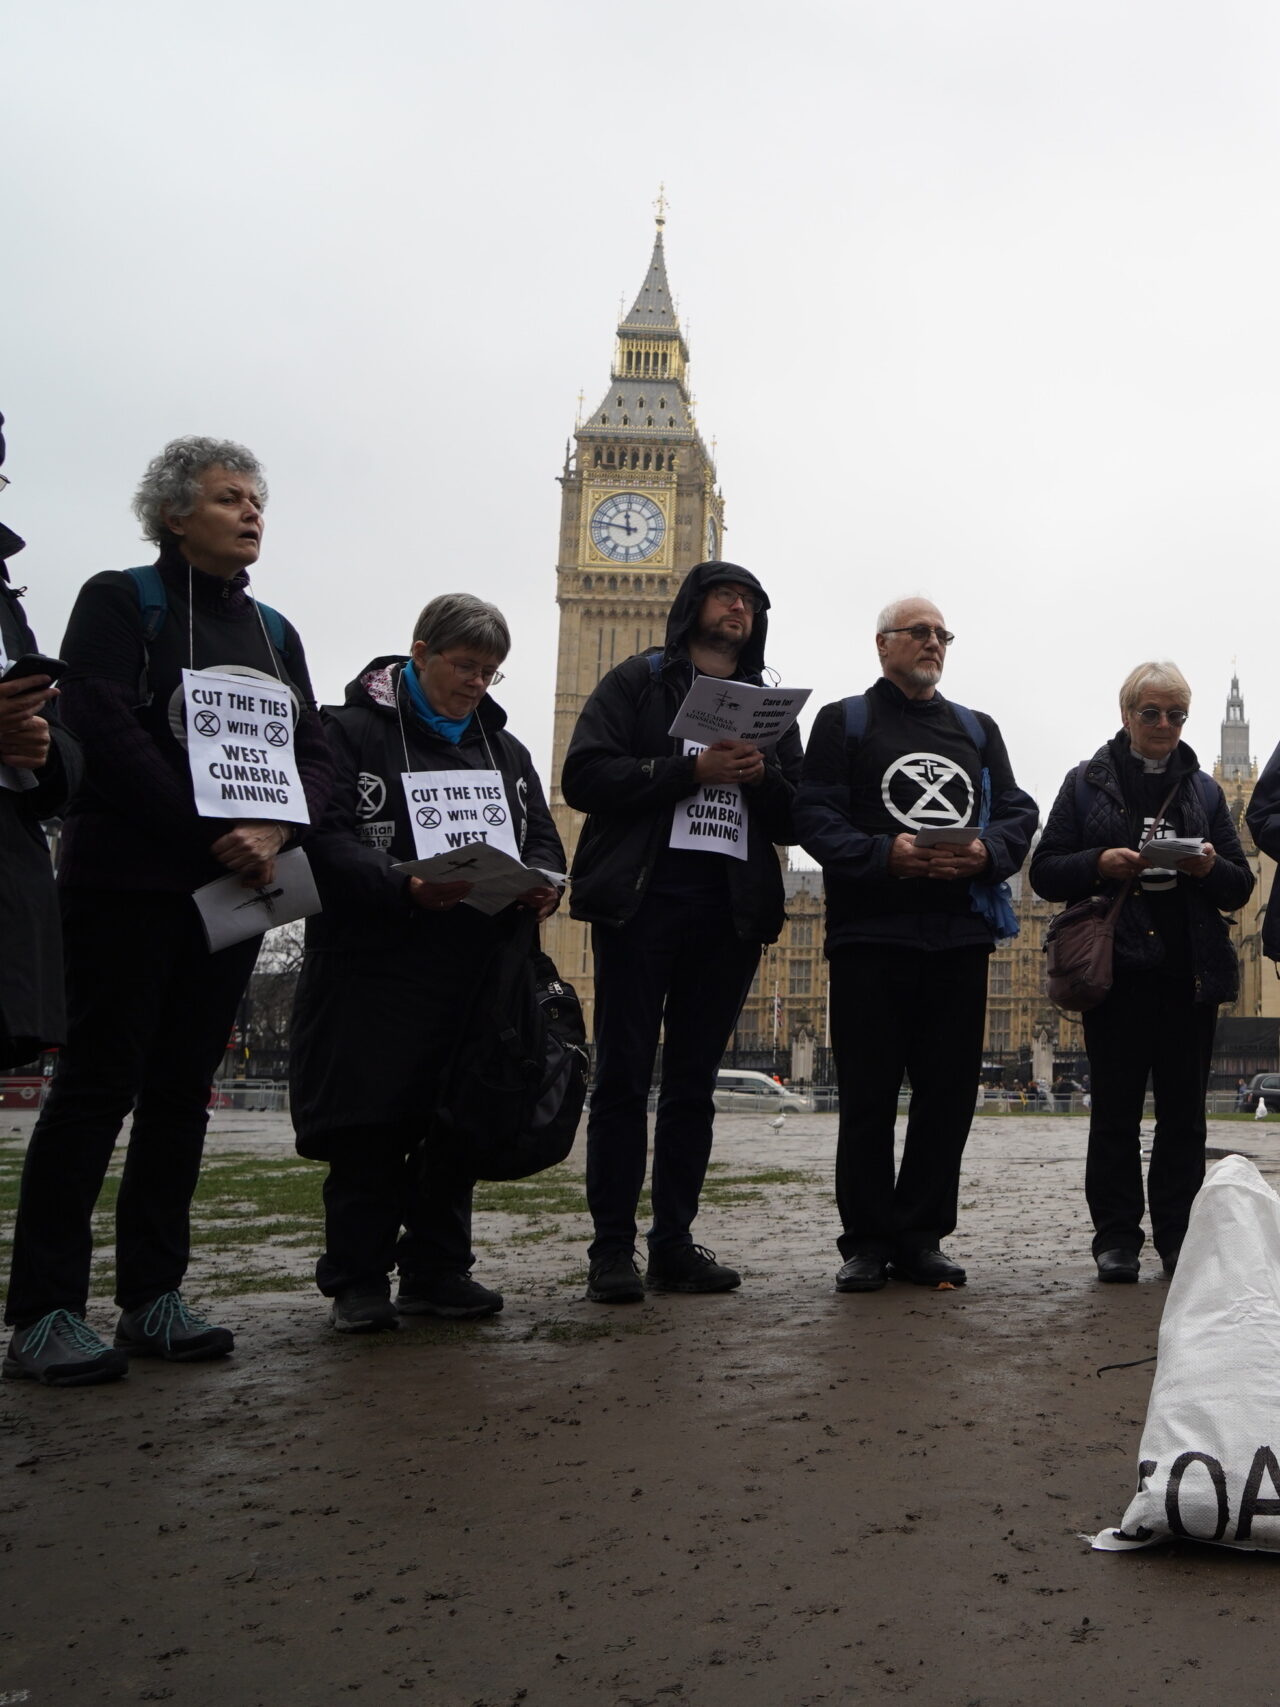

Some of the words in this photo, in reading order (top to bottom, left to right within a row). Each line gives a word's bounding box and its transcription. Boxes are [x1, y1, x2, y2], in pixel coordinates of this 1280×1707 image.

[191, 689, 222, 707] CUT
[228, 693, 255, 712] THE
[259, 699, 288, 718] TIES
[763, 698, 781, 706] Care
[227, 720, 258, 736] WITH
[221, 744, 268, 764] WEST
[208, 763, 291, 786] CUMBRIA
[221, 783, 289, 804] MINING
[411, 788, 438, 802] CUT
[444, 787, 471, 800] THE
[474, 786, 501, 800] TIES
[703, 788, 738, 807] WEST
[447, 809, 478, 821] WITH
[686, 804, 742, 828] CUMBRIA
[445, 831, 488, 848] WEST
[689, 821, 739, 842] MINING
